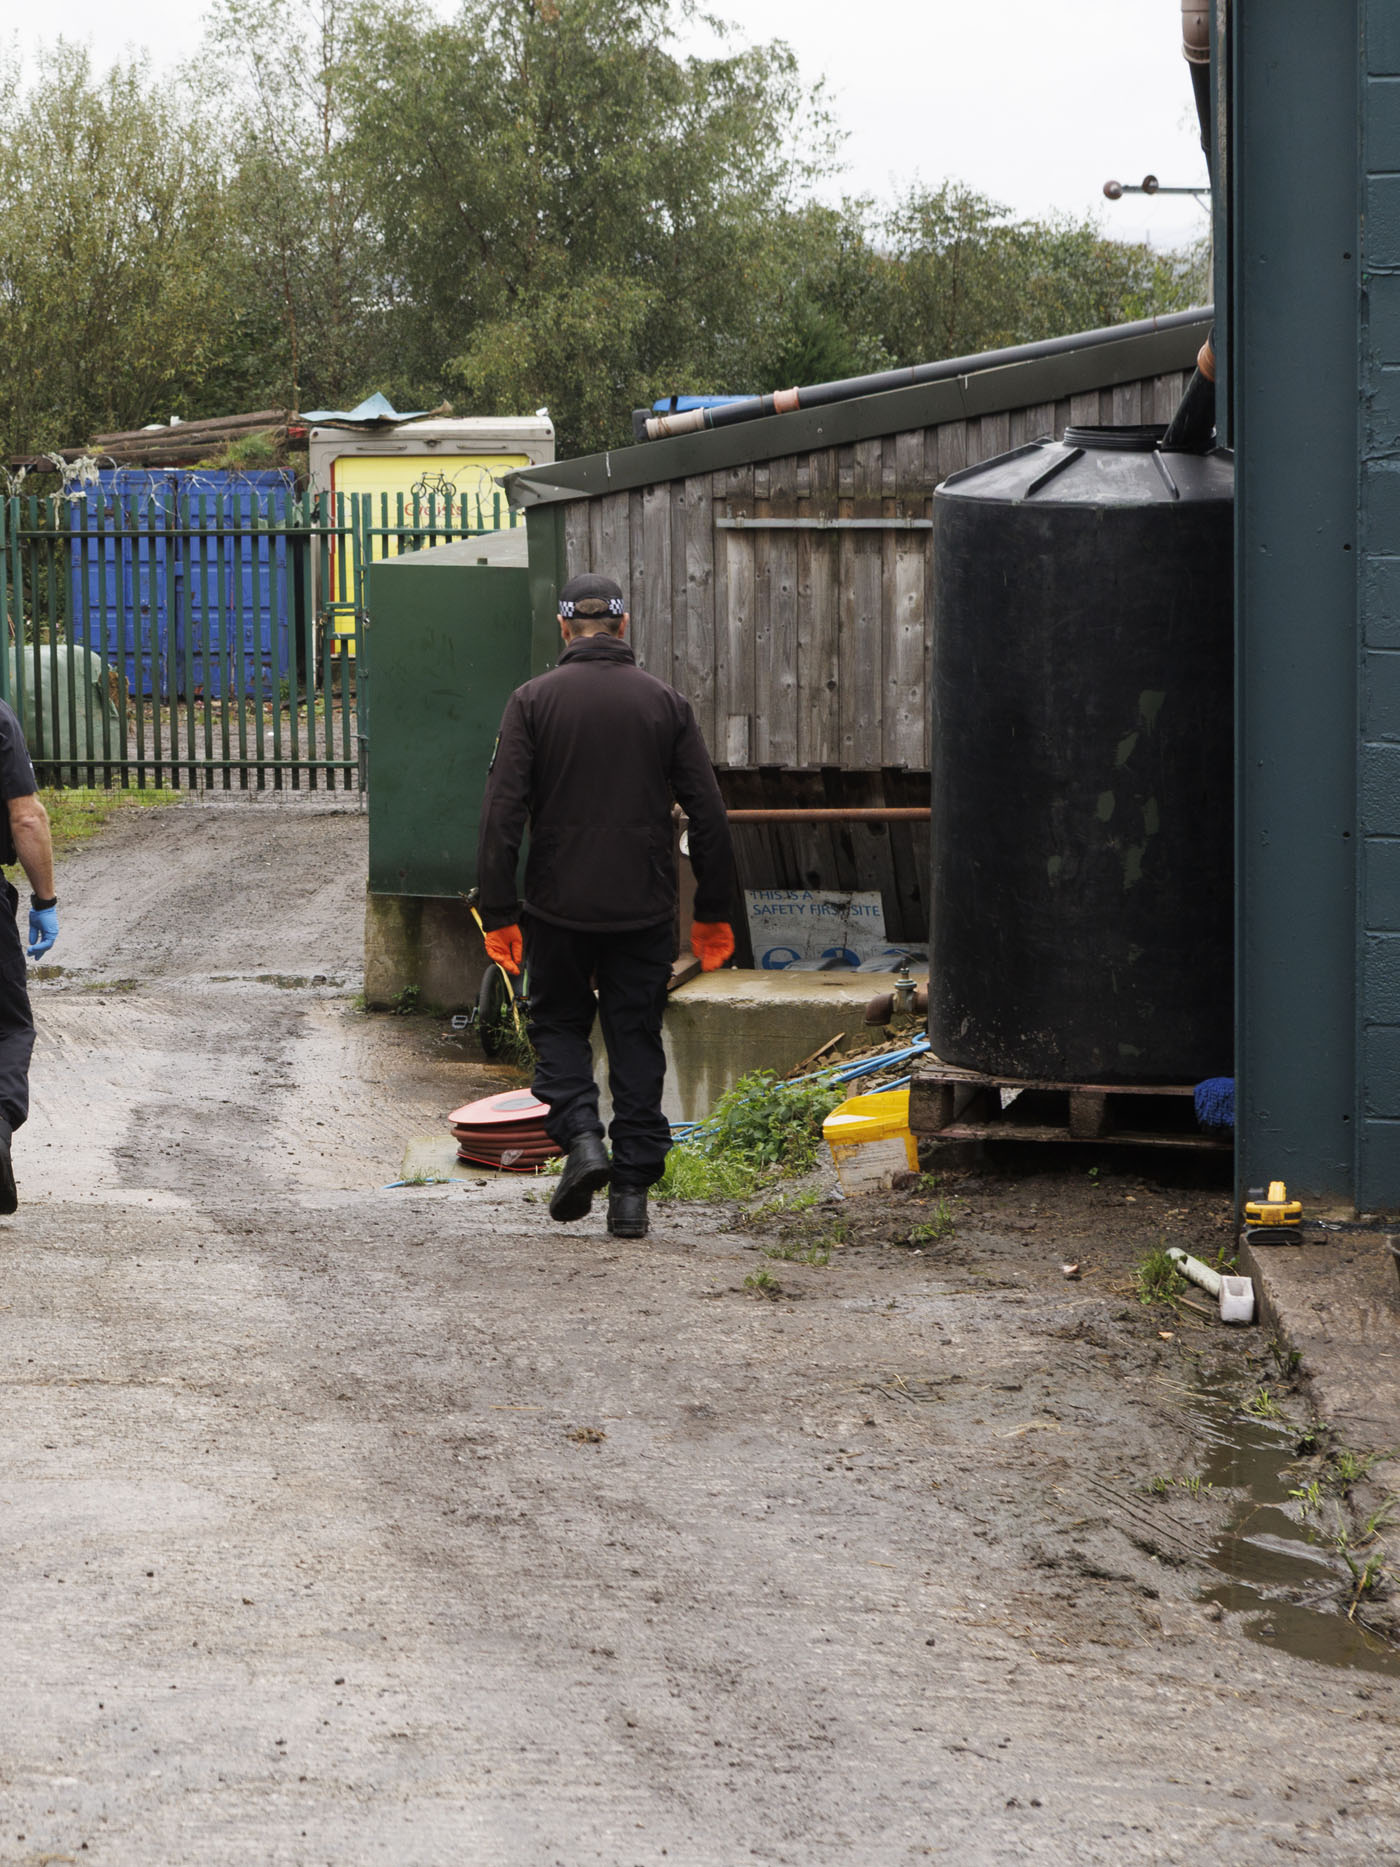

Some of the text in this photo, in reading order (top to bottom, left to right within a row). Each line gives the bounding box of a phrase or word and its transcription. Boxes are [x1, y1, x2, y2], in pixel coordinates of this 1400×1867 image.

[751, 890, 782, 900] THIS
[802, 890, 813, 900] A
[753, 904, 805, 915] SAFETY
[850, 905, 880, 917] SITE
